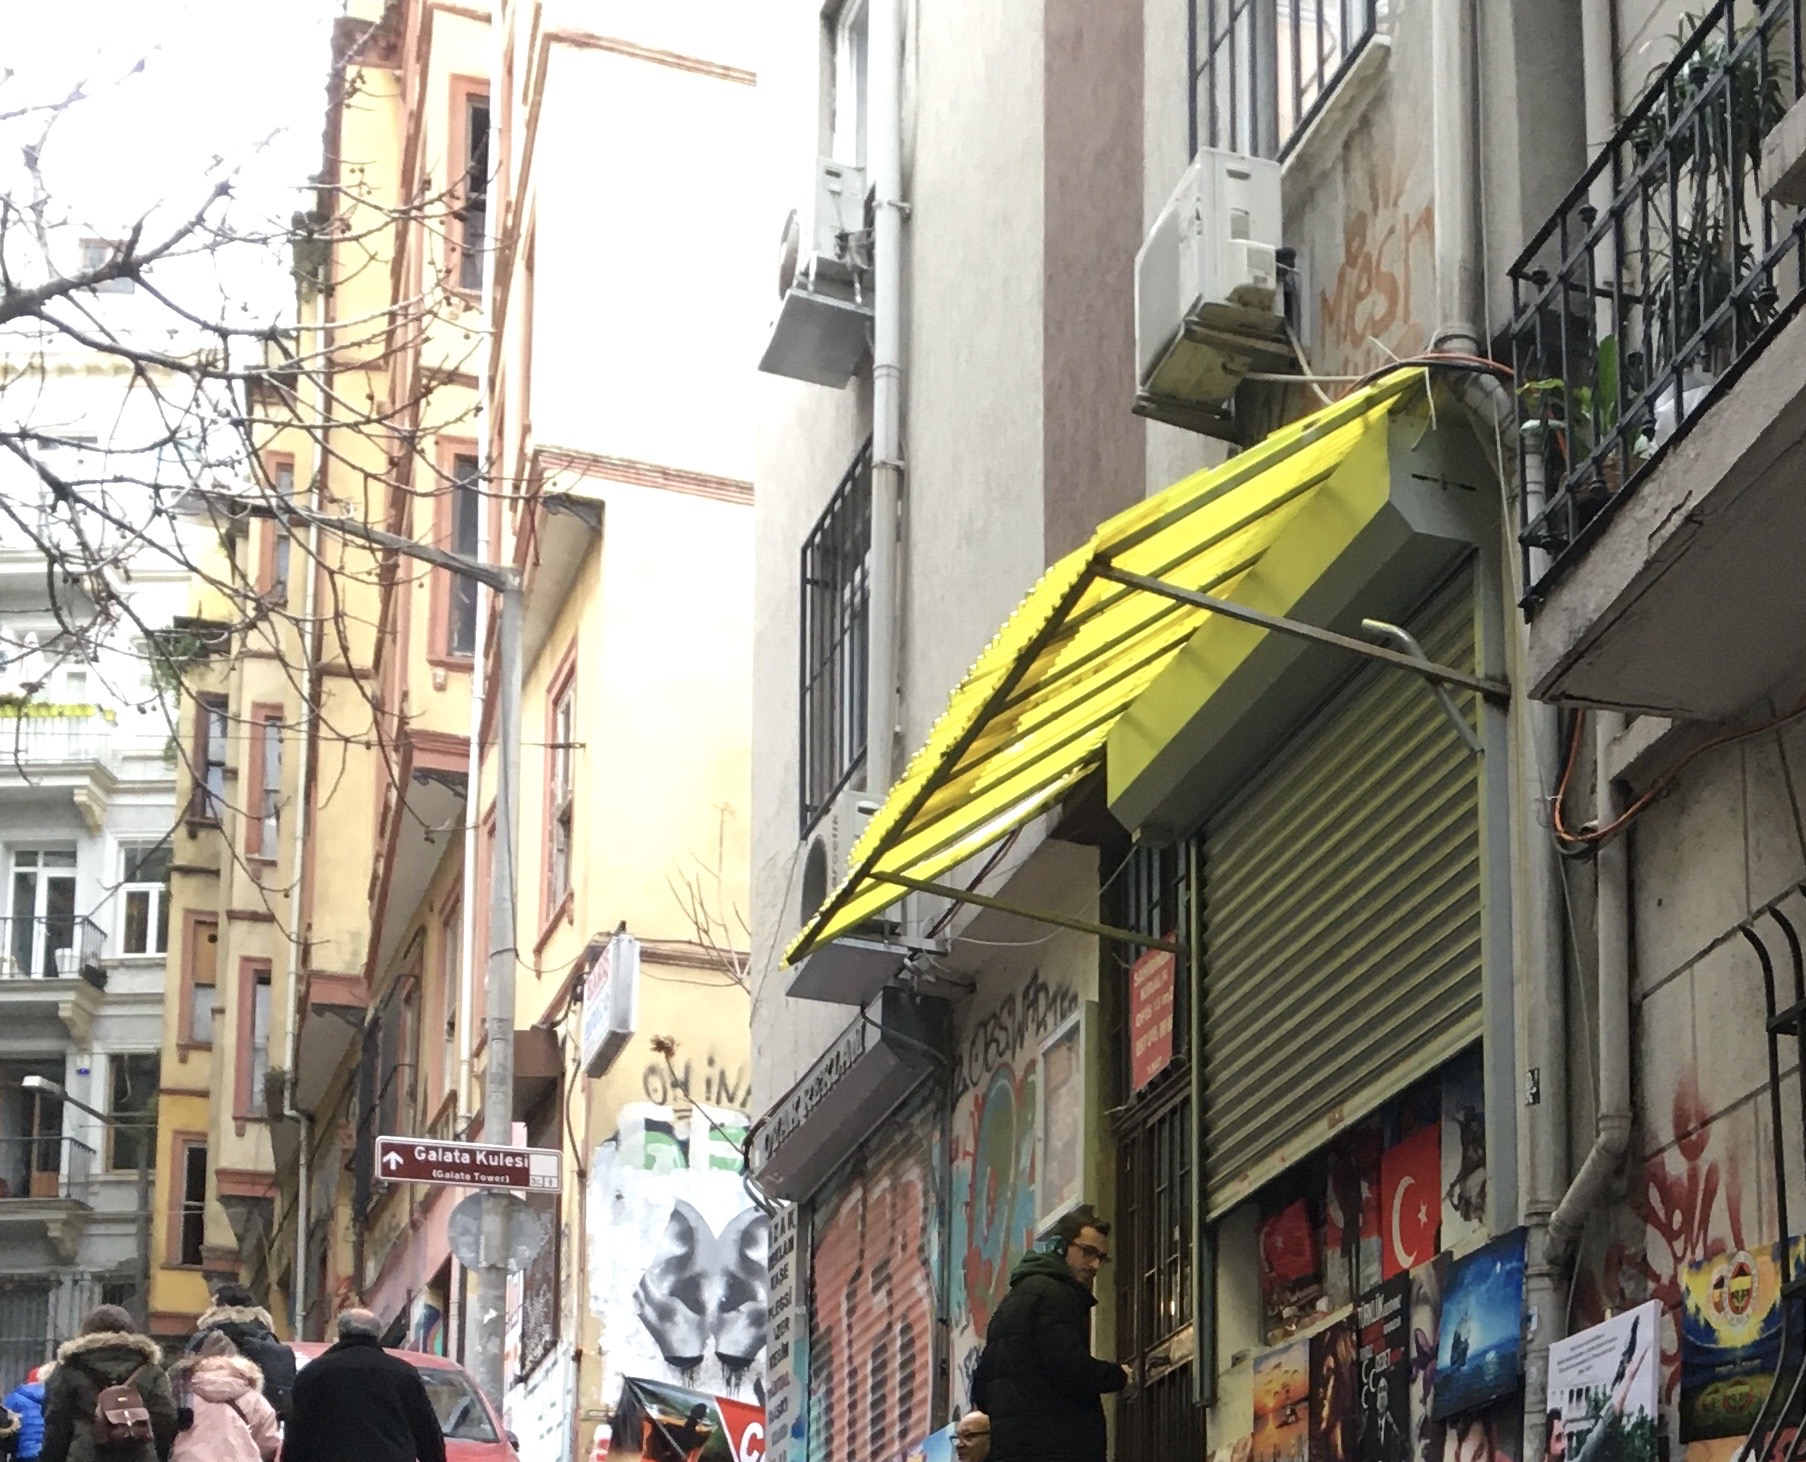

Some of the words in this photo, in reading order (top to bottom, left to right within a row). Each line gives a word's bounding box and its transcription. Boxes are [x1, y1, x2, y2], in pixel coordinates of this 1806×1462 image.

[413, 1145, 471, 1165] Galata
[475, 1150, 529, 1169] Kulesi
[474, 1171, 510, 1184] Tower)
